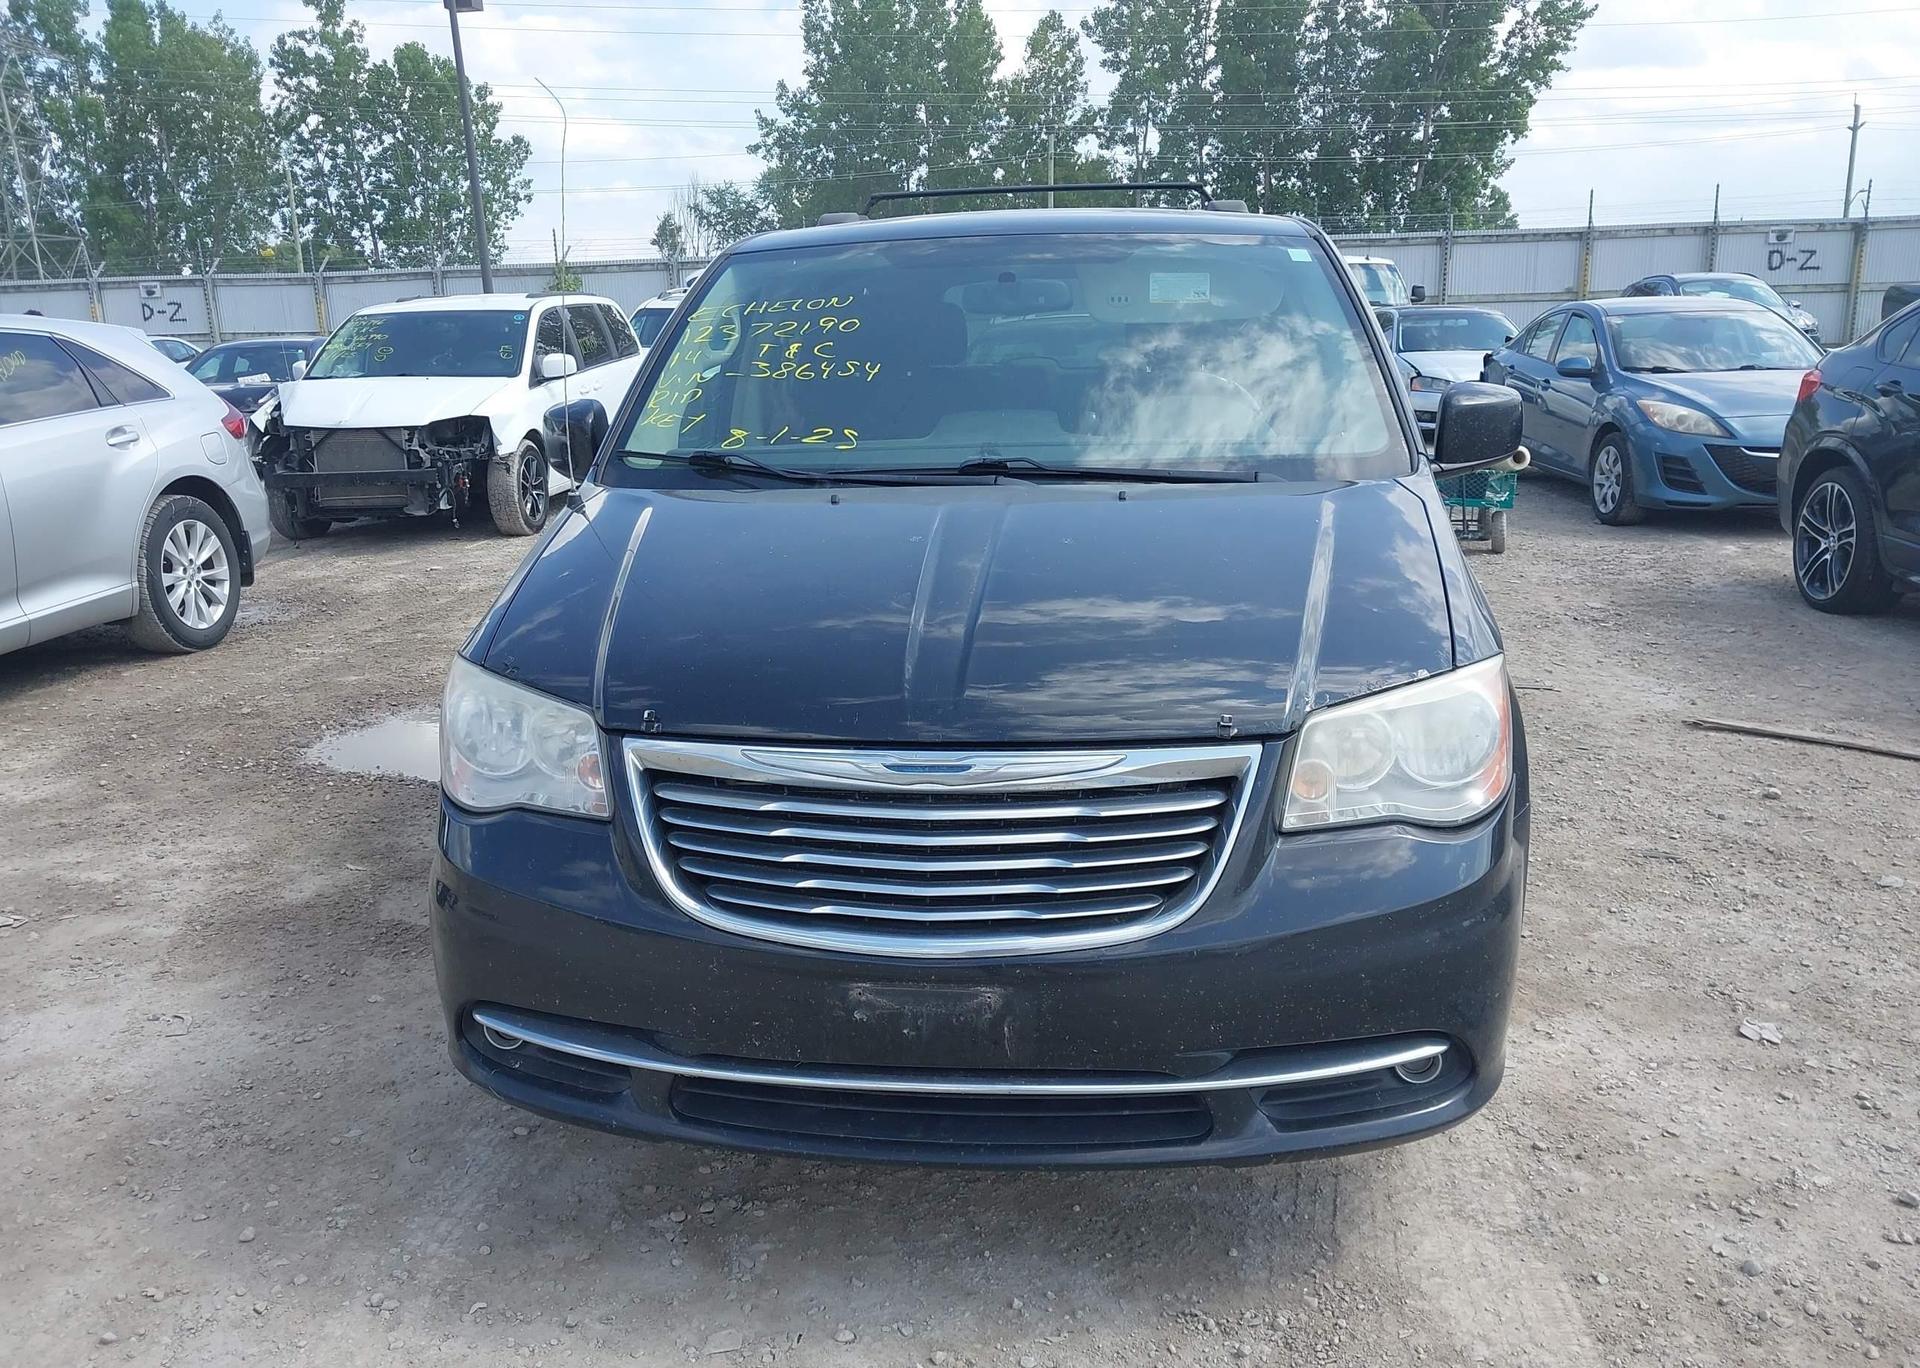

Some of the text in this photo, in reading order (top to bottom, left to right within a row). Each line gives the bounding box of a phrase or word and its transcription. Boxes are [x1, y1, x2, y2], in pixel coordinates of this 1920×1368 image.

[687, 296, 854, 322] ECHELON
[683, 317, 861, 345] 12372190
[760, 343, 780, 357] T
[814, 342, 835, 358] C
[641, 408, 706, 434] KEY
